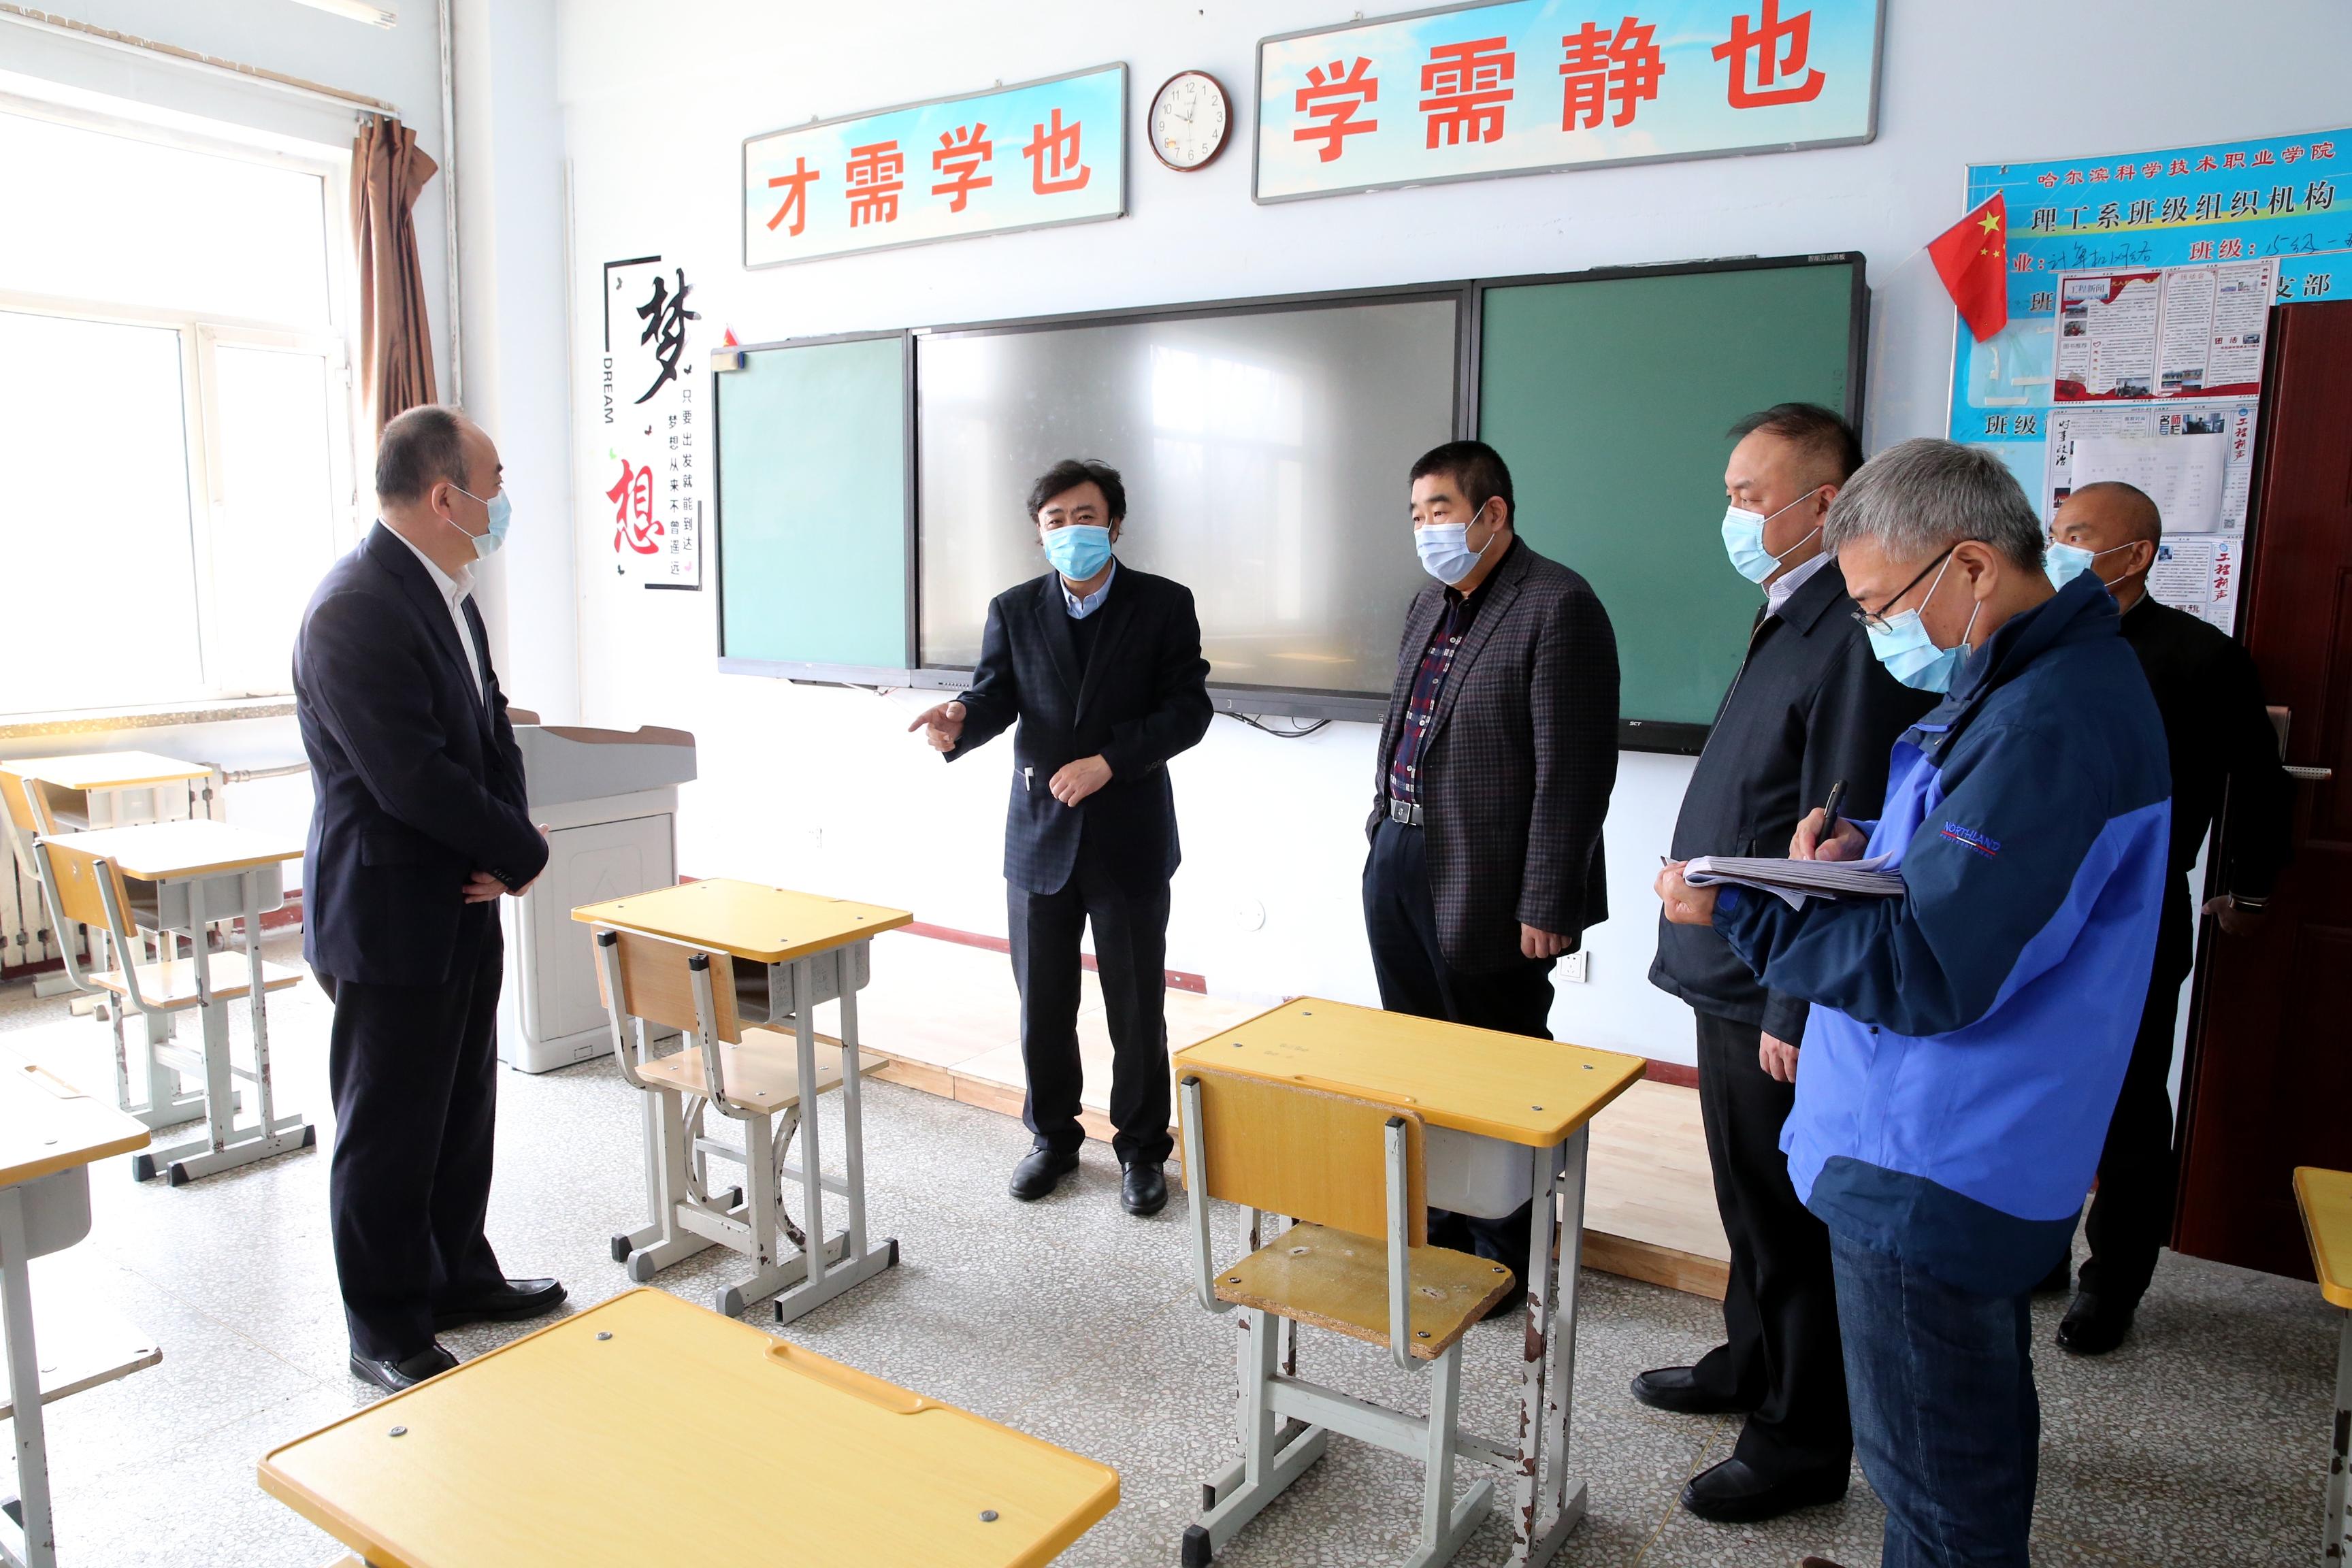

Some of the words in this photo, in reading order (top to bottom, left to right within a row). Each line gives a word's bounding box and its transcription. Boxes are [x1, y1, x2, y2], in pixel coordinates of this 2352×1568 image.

[1293, 0, 1827, 163] 学需静也
[1186, 82, 1195, 93] 12
[1202, 85, 1207, 96] 1
[1171, 91, 1179, 101] 11
[1211, 95, 1218, 106] 2
[1163, 103, 1172, 114] 10
[1217, 112, 1223, 122] 3
[1159, 121, 1165, 131] 9
[1212, 129, 1218, 139] 4
[1175, 147, 1180, 158] 7
[1202, 143, 1208, 154] 5
[1188, 150, 1194, 161] 6
[2037, 141, 2336, 188] 哈尔滨科学技术职业学院
[766, 108, 1091, 237] 才需学也
[2030, 180, 2336, 233] 理工系班级组织机构
[2072, 284, 2105, 294] 工程新闻
[603, 357, 614, 423] DREAM
[1984, 415, 2047, 434] 班级
[683, 389, 693, 551] 只要出发就能到达
[668, 414, 680, 575] 梦想从来不曾遥远
[1943, 820, 2001, 851] NORTHLAND
